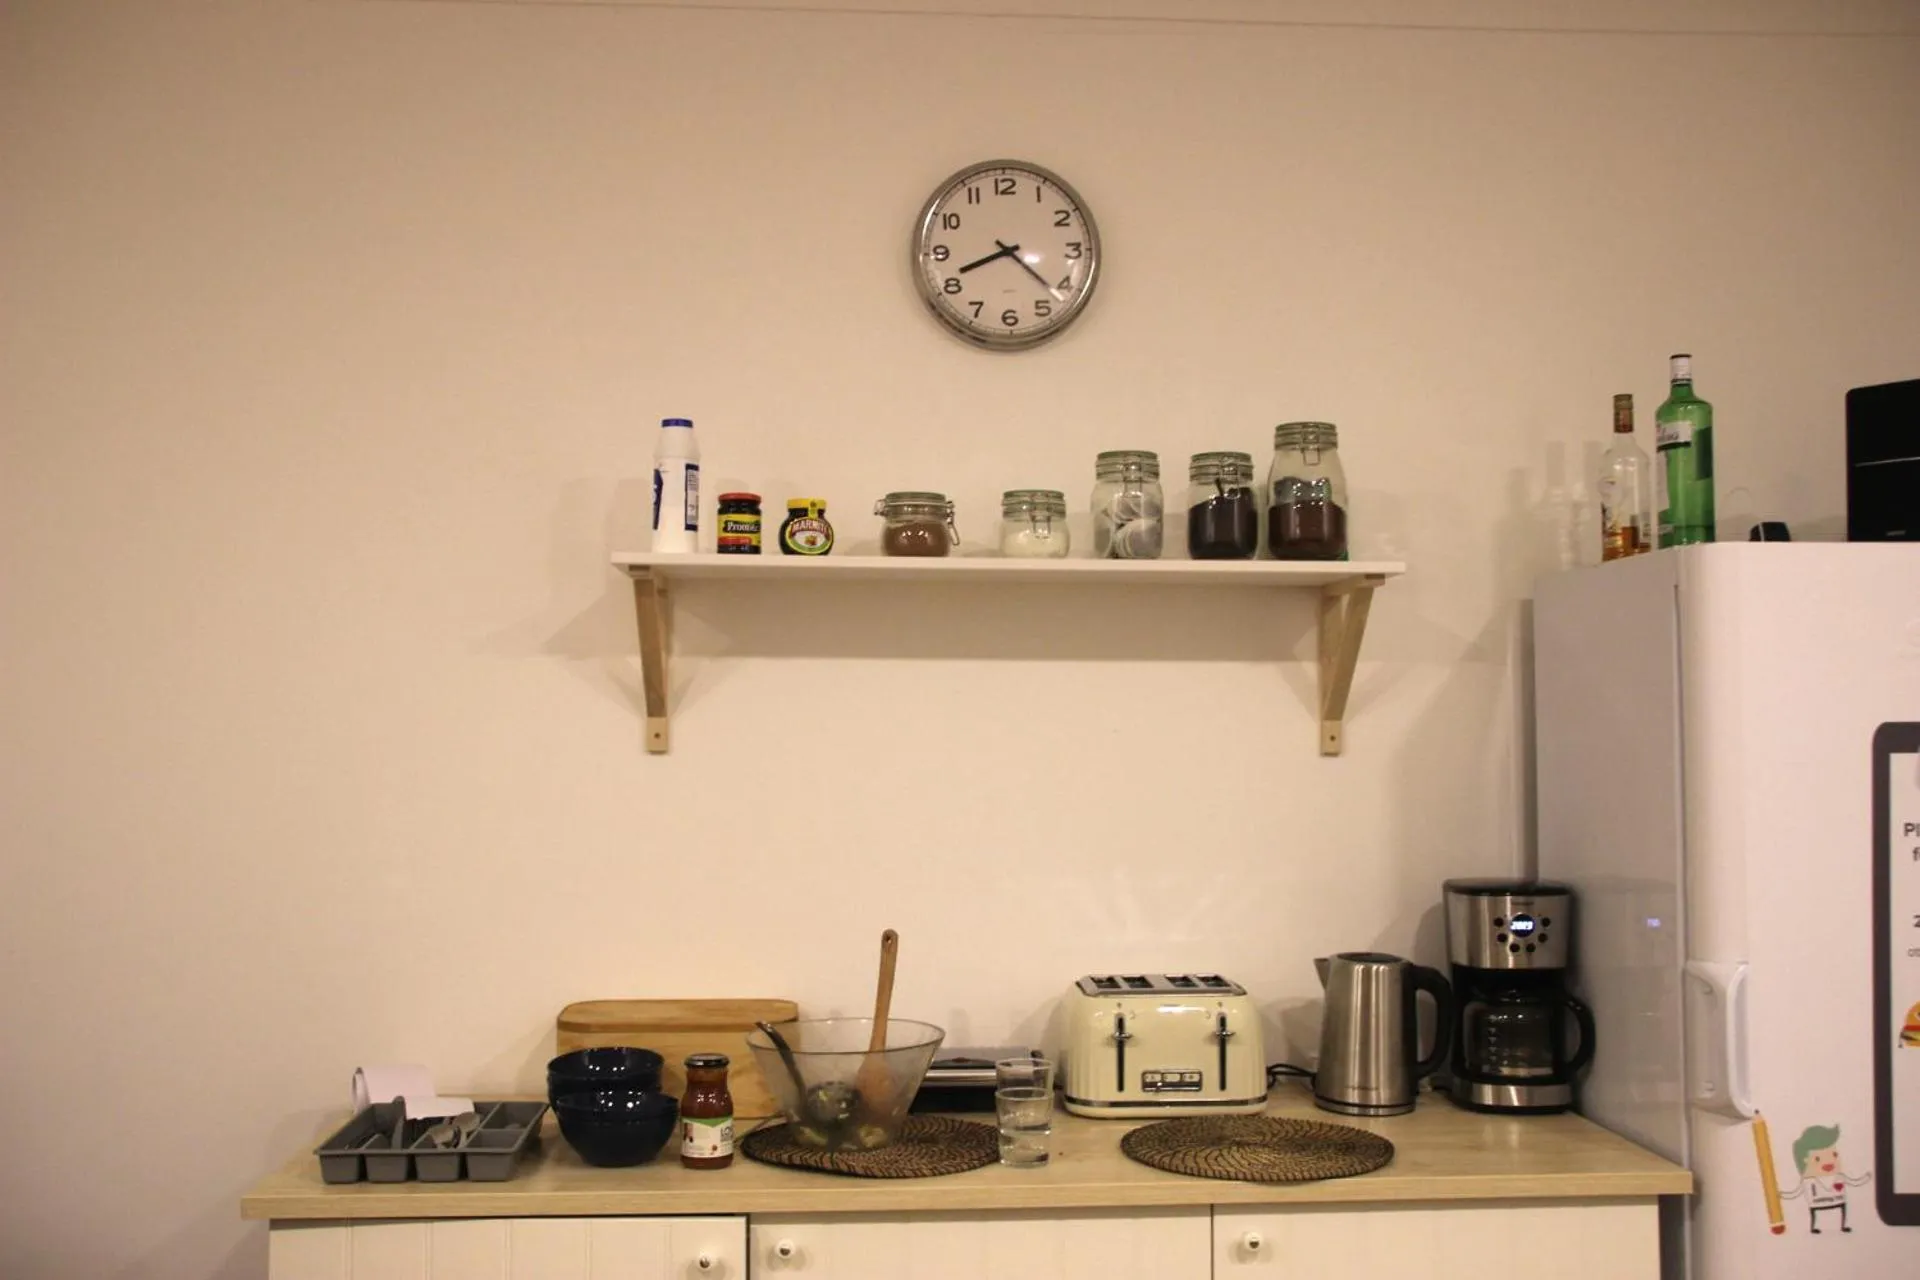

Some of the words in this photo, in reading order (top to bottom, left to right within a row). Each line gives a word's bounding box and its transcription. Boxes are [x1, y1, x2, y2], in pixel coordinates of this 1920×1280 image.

[968, 186, 981, 205] 11
[994, 178, 1016, 196] 12
[1036, 185, 1042, 203] 1
[943, 213, 960, 231] 10
[1054, 210, 1071, 227] 2
[932, 245, 950, 262] 9
[1065, 242, 1082, 260] 3
[943, 277, 962, 294] 8
[1056, 276, 1075, 292] 4
[969, 301, 984, 319] 7
[1035, 300, 1052, 317] 5
[1001, 309, 1019, 327] 6
